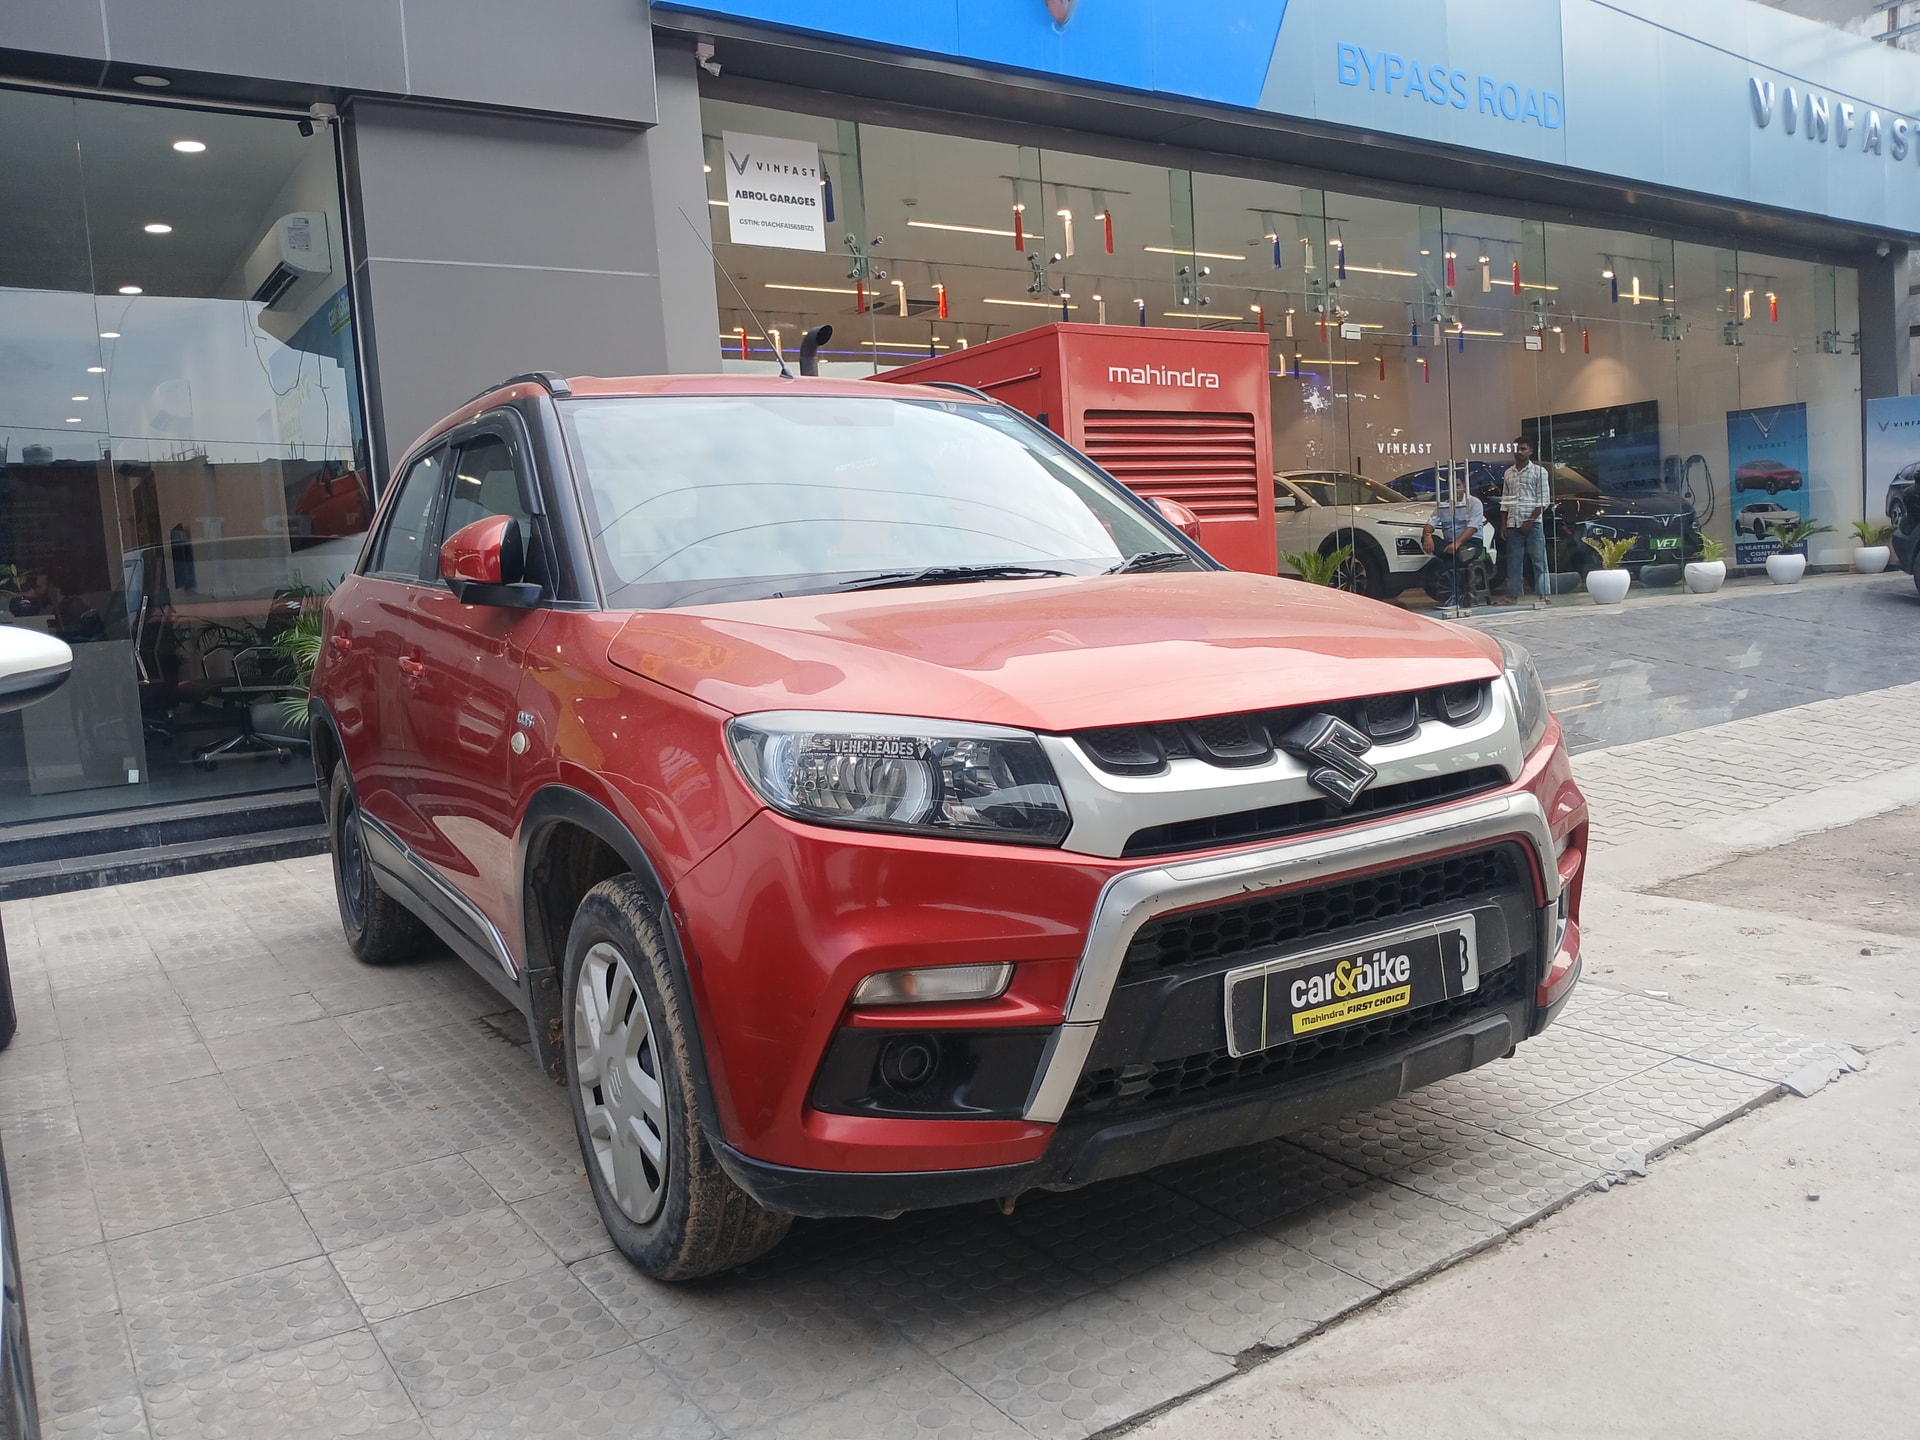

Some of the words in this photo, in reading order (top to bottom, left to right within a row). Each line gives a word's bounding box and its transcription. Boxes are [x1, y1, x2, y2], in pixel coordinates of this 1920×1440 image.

[1337, 41, 1469, 110] BYPASS
[1478, 75, 1563, 129] ROAD
[756, 161, 816, 178] VINFAST
[735, 190, 768, 202] ABROL
[769, 193, 816, 207] GARAGES
[739, 218, 760, 226] GSTIN:
[1108, 364, 1219, 388] mahindra
[1377, 442, 1432, 454] VINFAST
[1470, 442, 1519, 454] VINFAST
[1748, 441, 1787, 451] VINFAST
[1656, 538, 1677, 548] VF7
[835, 739, 914, 756] VEHICLEADES
[1290, 951, 1410, 1008] car&bike
[1301, 1009, 1344, 1026] Mahindra
[1347, 999, 1374, 1014] FIRST
[1374, 992, 1406, 1007] CHOICE
